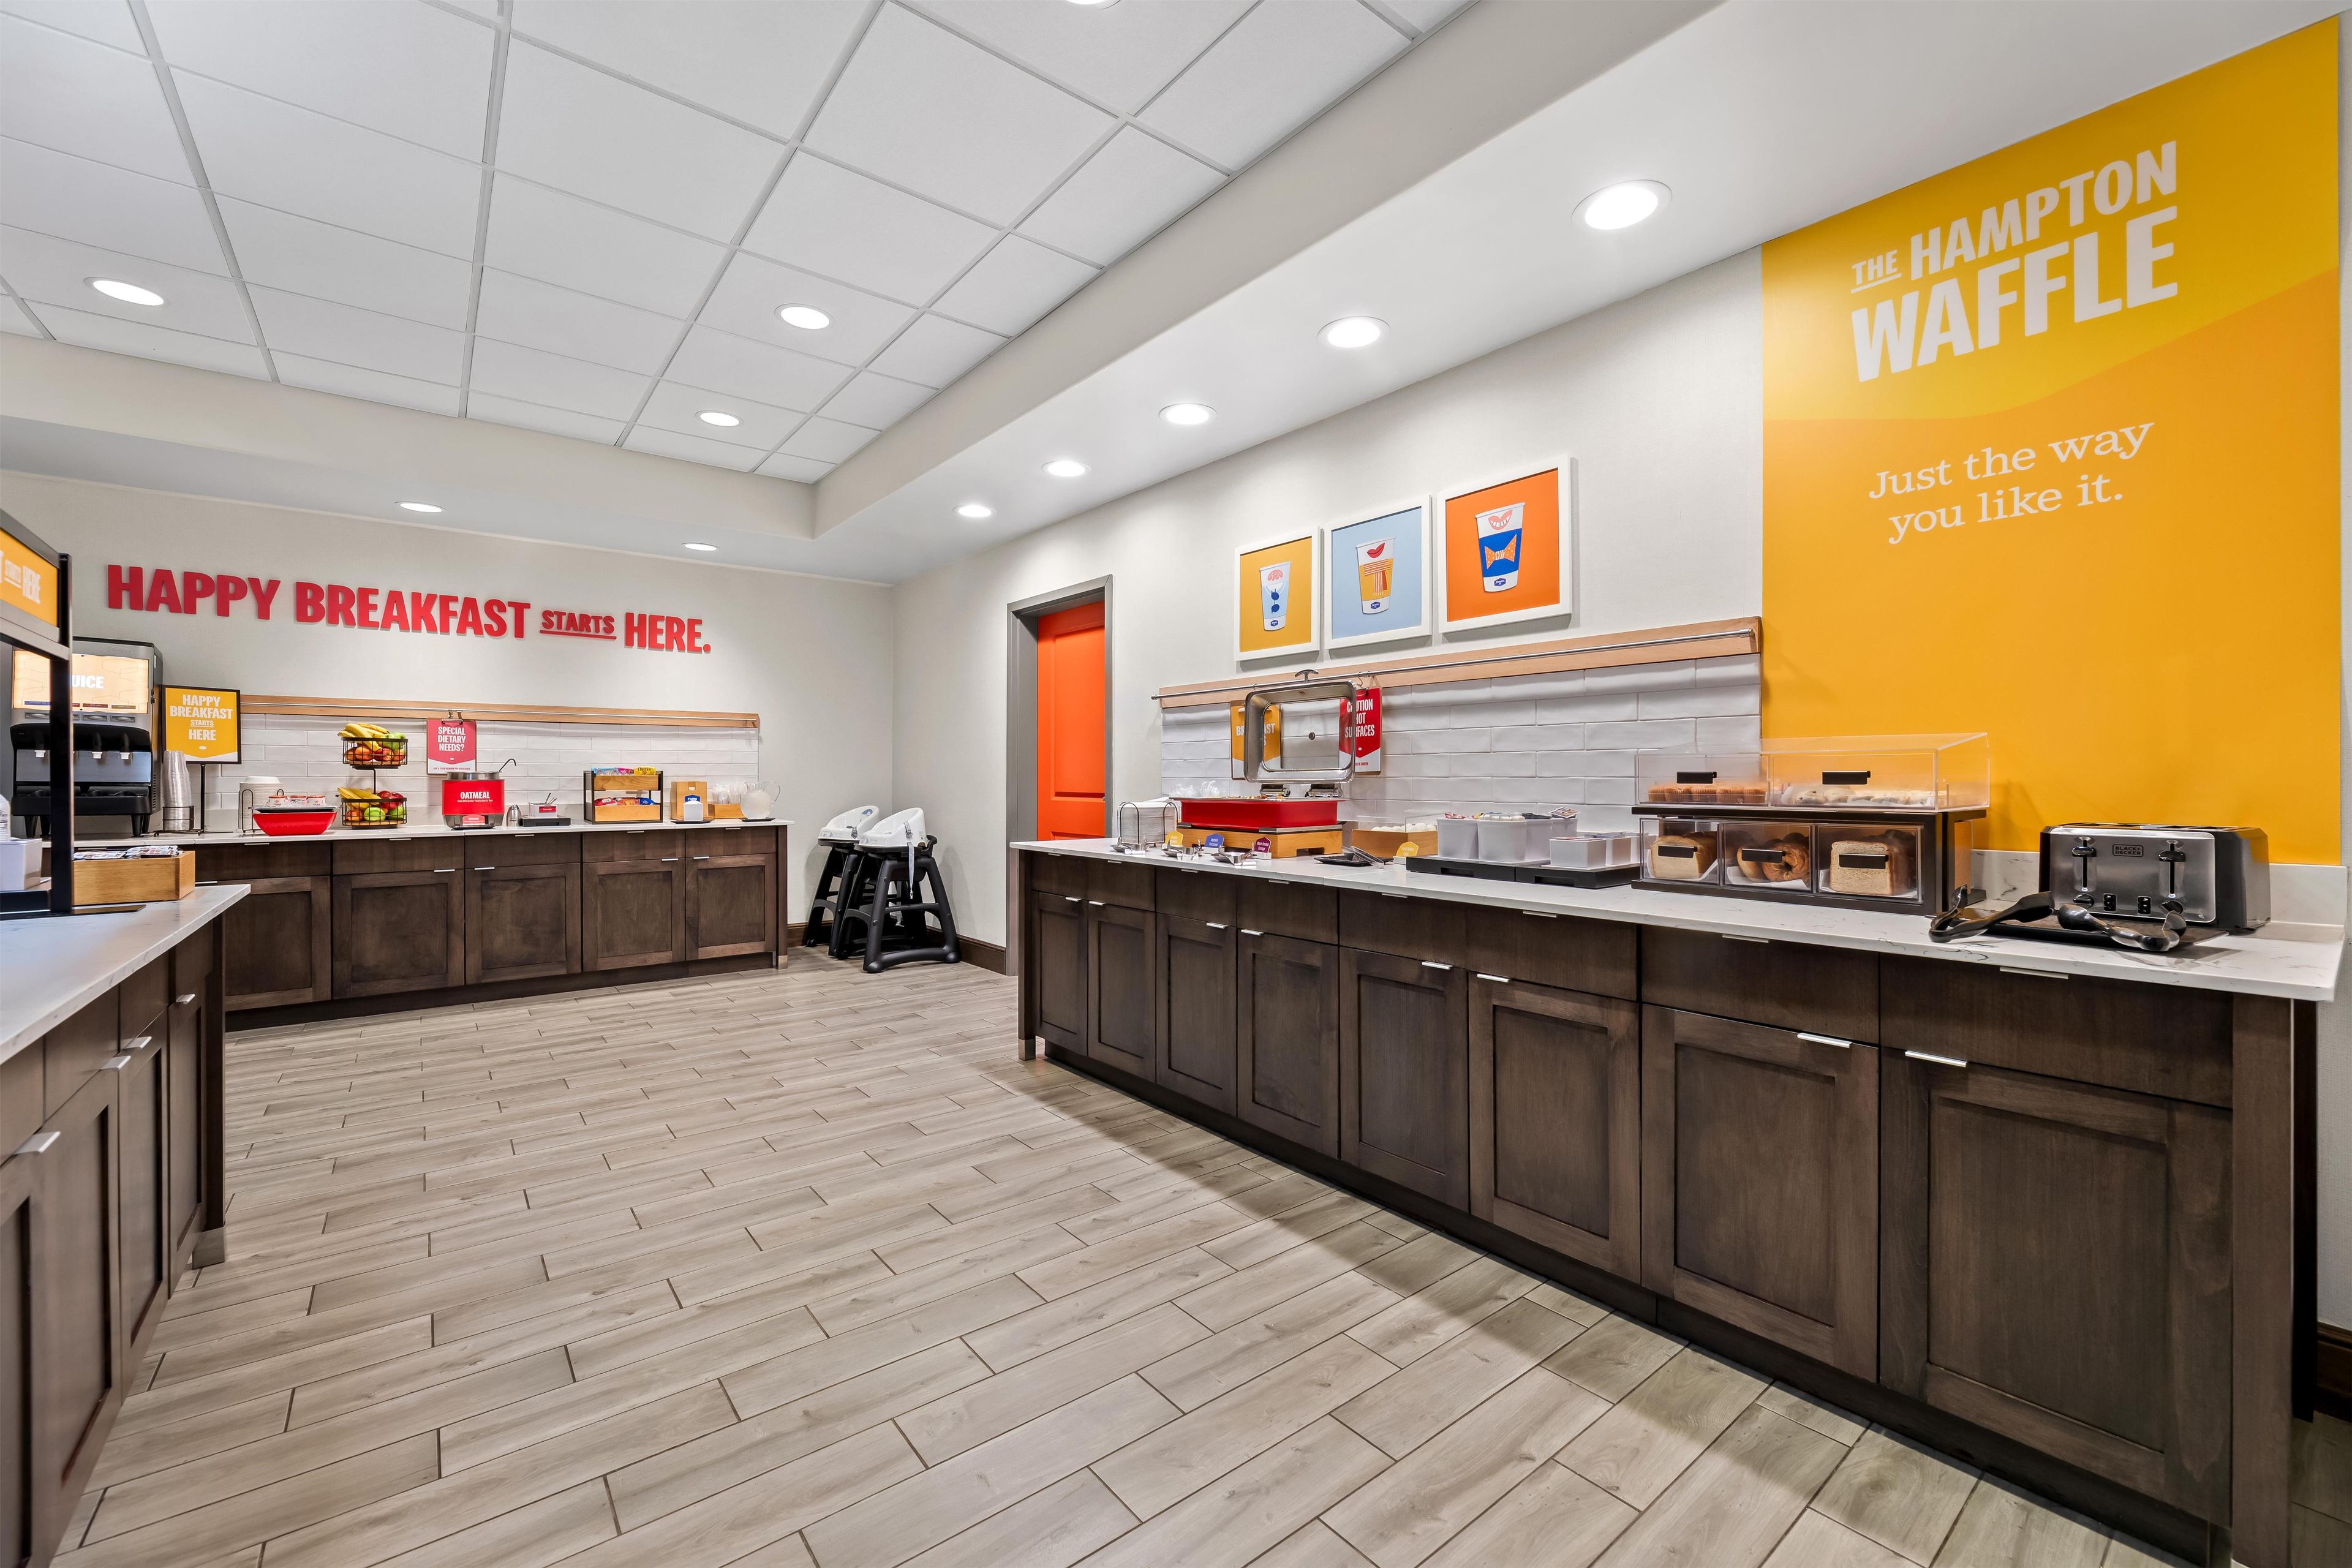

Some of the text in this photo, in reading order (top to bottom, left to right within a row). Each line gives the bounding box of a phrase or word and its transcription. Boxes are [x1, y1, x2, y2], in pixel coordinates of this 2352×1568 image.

[1850, 140, 2177, 287] THE HAMPTON
[1851, 205, 2178, 383] WAFFLE
[1869, 422, 2155, 499] Just the way
[1888, 474, 2123, 545] you like it.
[107, 564, 712, 654] HAPPY BREAKFAST STARTS HERE.
[71, 674, 105, 689] UICE
[183, 694, 221, 707] HAPPY
[1346, 699, 1373, 713] CUTION
[170, 705, 233, 720] BREAKFAST
[188, 729, 216, 741] HERE
[437, 726, 466, 736] SPECIAL
[437, 734, 466, 744] DIETARY
[439, 743, 465, 752] NEEDS?
